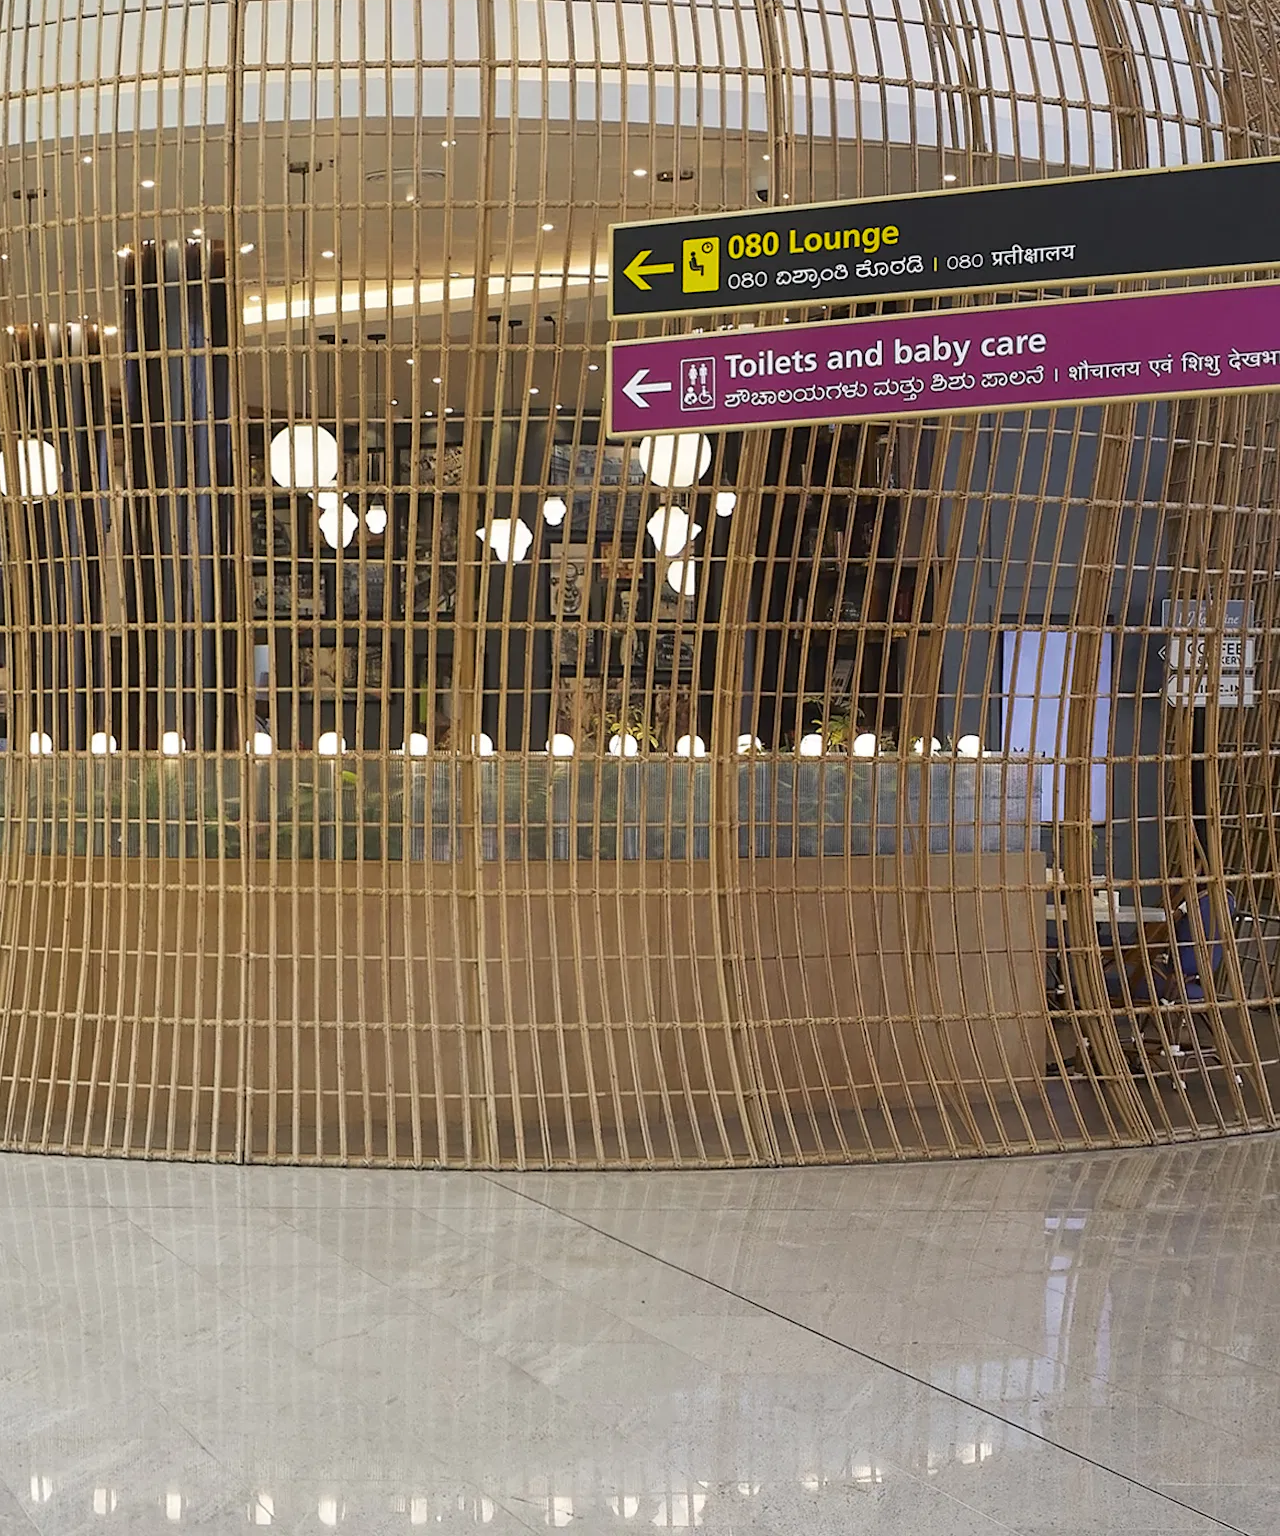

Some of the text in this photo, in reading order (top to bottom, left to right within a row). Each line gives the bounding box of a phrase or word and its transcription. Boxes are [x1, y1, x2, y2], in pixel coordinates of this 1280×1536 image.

[727, 224, 900, 260] 080 Lounge
[946, 243, 1077, 271] 080 प्रतीक्षालय
[727, 254, 925, 290] 080 ವಿಶ್ರಾಂತಿ ಕೊಠಡಿ
[723, 331, 1048, 379] Toilets and baby care
[1067, 359, 1142, 382] शौचालय
[1147, 353, 1174, 378] एवं
[1180, 351, 1221, 377] शिशु
[723, 364, 1046, 408] ಶೌಚಾಲಯಗಳು ಮತ್ತು ಶಿಶು ಪಾಲನೆ
